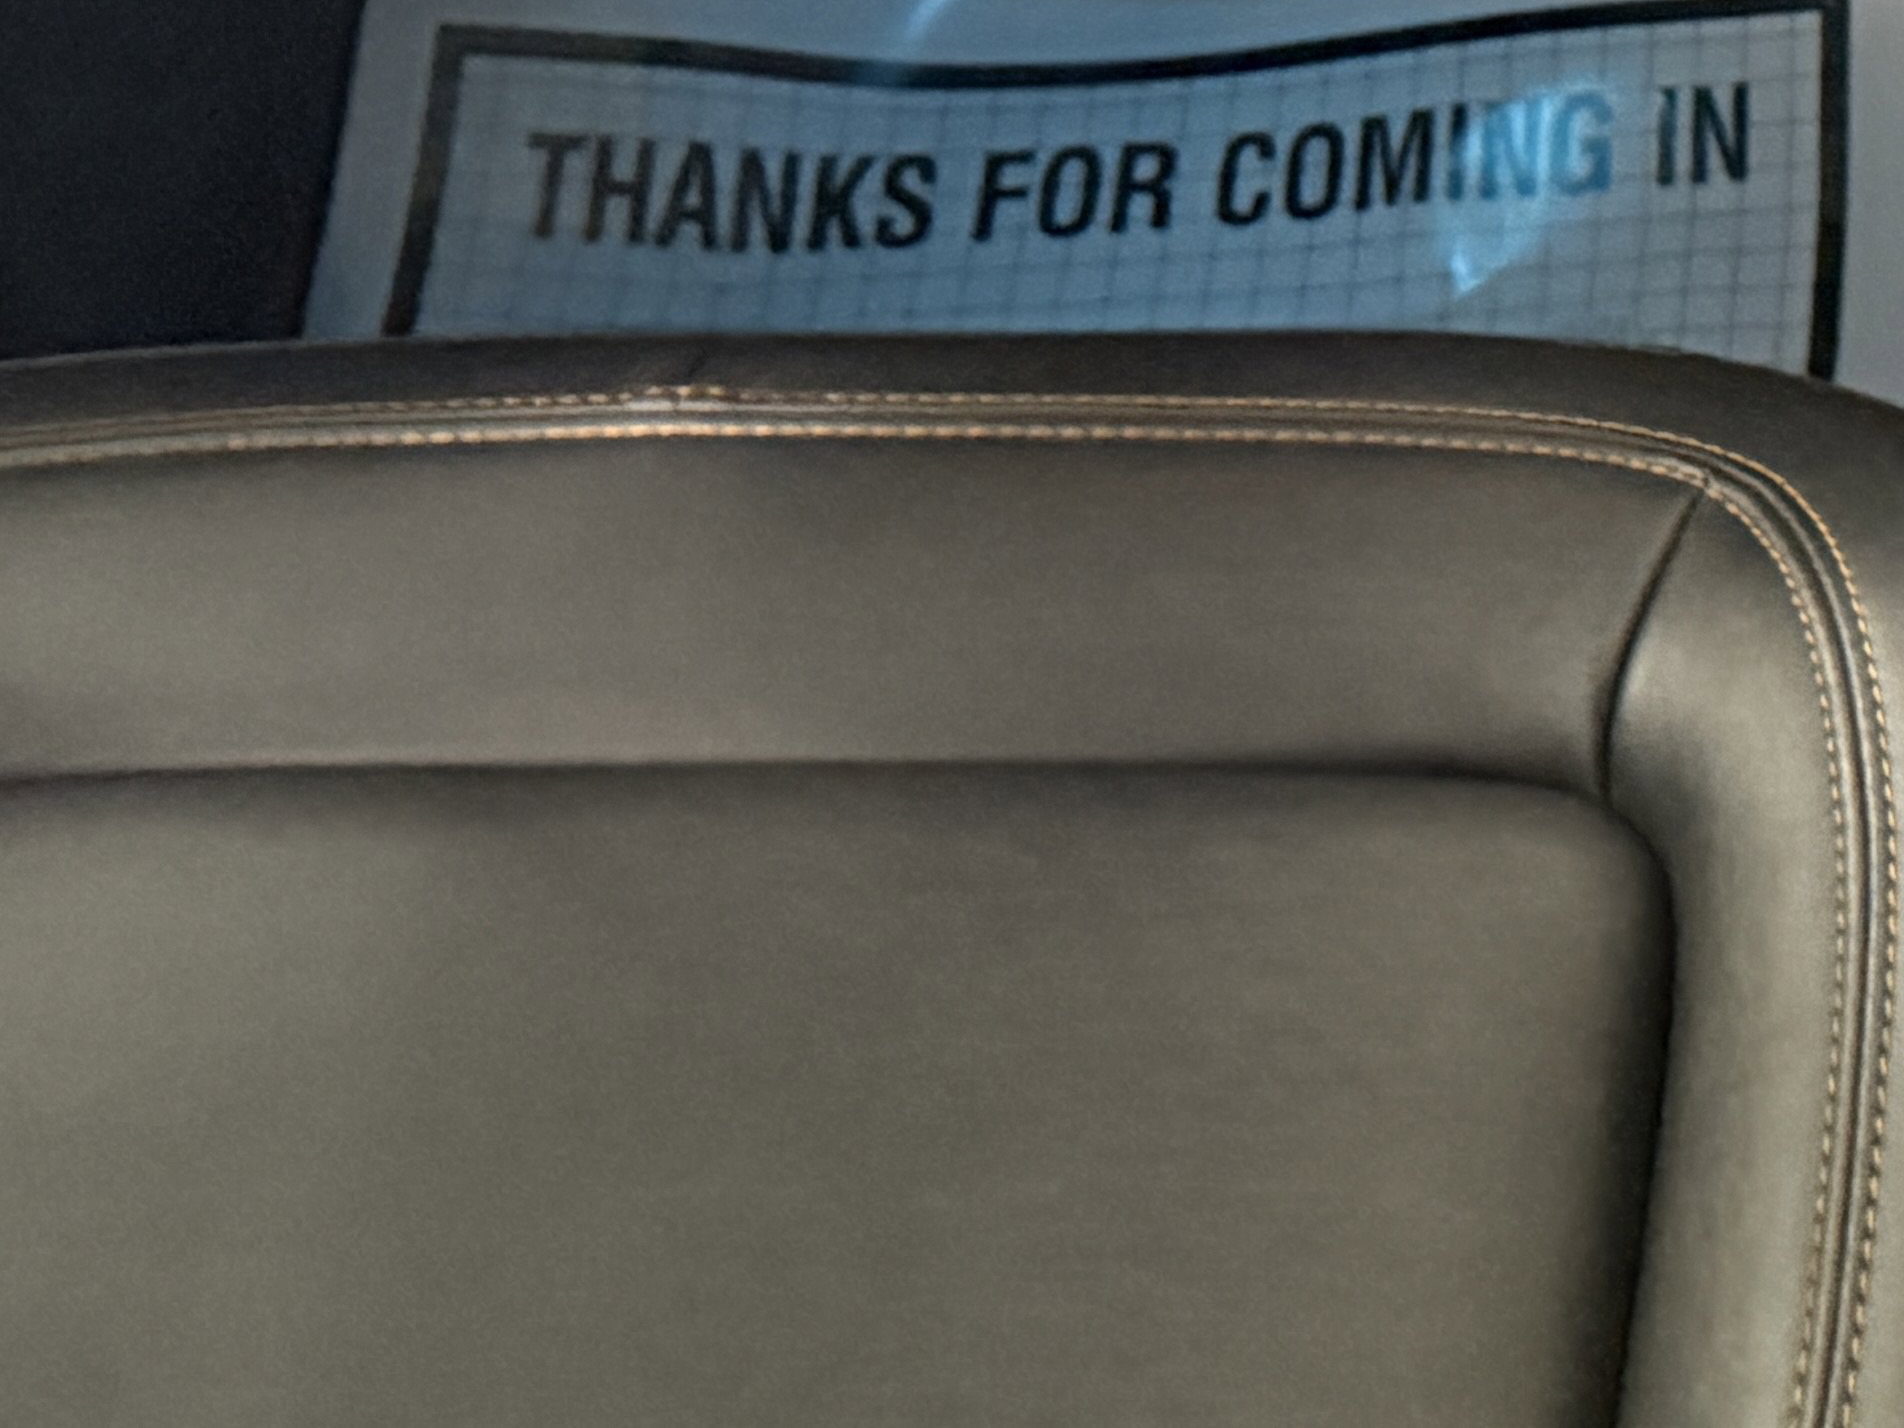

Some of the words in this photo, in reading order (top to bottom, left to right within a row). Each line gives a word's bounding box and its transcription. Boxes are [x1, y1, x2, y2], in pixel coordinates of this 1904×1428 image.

[528, 132, 938, 252] THANKS
[971, 142, 1179, 242] FOR
[1216, 89, 1615, 227] COMING
[1656, 81, 1750, 187] IN
